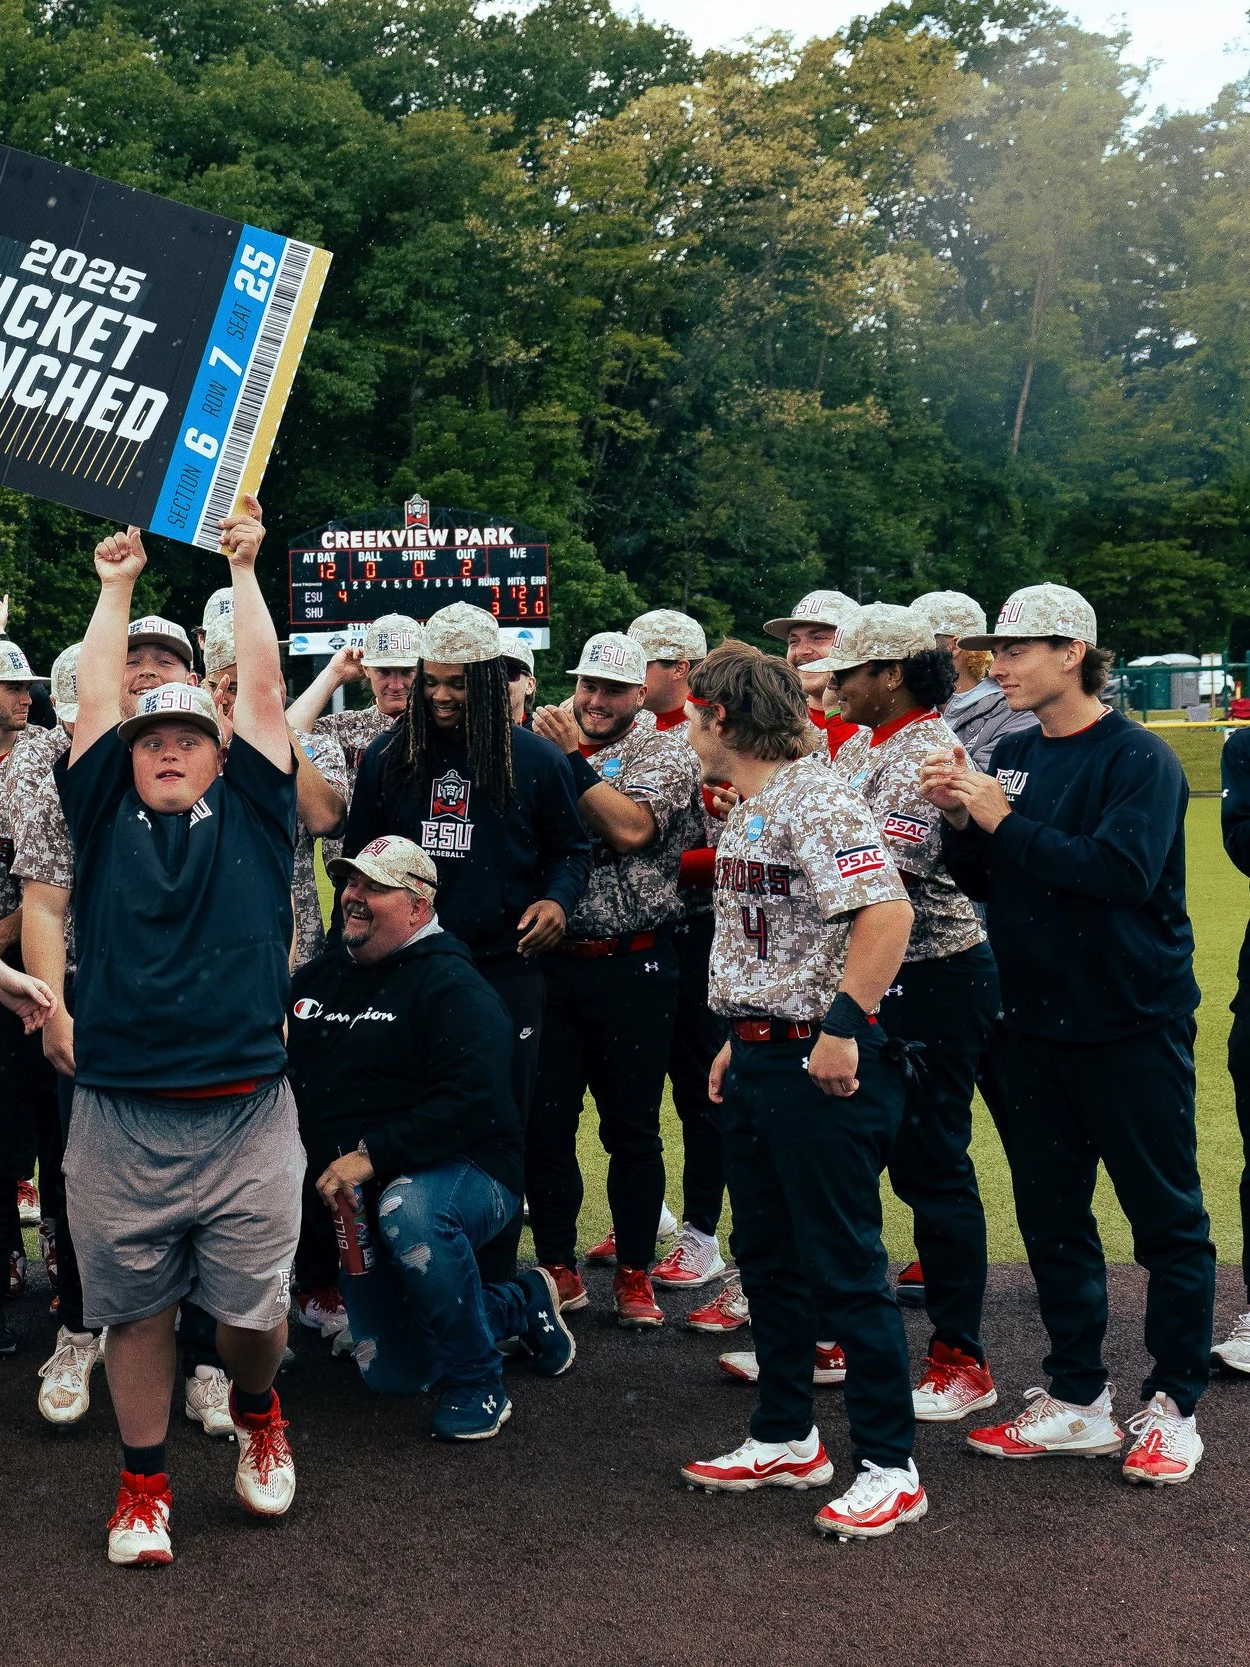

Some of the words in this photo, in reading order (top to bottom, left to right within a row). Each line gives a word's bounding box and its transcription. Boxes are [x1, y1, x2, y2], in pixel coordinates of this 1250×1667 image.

[19, 238, 147, 303] 2025
[233, 243, 276, 304] 25
[226, 300, 253, 341] SEAT
[208, 345, 243, 378] 7
[202, 378, 228, 418] ROW
[183, 426, 220, 460] 6
[167, 463, 203, 530] SECTION
[321, 528, 449, 549] CREEKVIEW
[454, 527, 515, 546] PARK
[302, 552, 315, 563] AT
[317, 551, 336, 563] BAT
[358, 551, 383, 562] BALL
[402, 550, 436, 561] STRIKE
[456, 548, 477, 560] OUT
[509, 547, 527, 559] H/E
[319, 562, 337, 579] 12
[365, 561, 376, 578] 0
[413, 560, 425, 577] 0
[462, 559, 472, 576] 2
[340, 581, 346, 589] 1
[352, 580, 358, 589] 2
[365, 580, 372, 589] 3
[381, 579, 387, 588] 4
[393, 579, 400, 588] 5
[406, 579, 413, 588] 6
[422, 579, 429, 588] 7
[435, 578, 441, 588] 8
[447, 578, 454, 588] 9
[461, 578, 472, 587] 10
[478, 577, 501, 587] RUNS
[507, 576, 526, 586] HITS
[530, 576, 547, 585] ERR
[304, 591, 323, 603] ESU
[337, 590, 348, 602] 4
[491, 586, 500, 599] 7
[511, 585, 527, 599] 12
[539, 586, 544, 598] 1
[305, 607, 324, 618] SHU
[491, 601, 500, 615] 3
[519, 601, 528, 615] 5
[535, 600, 544, 614] 0
[378, 632, 411, 651] ESU
[589, 644, 627, 667] ESU
[144, 690, 195, 714] ESU
[420, 820, 475, 850] ESU
[884, 818, 929, 839] PSAC
[425, 850, 466, 858] BASEBALL
[836, 849, 884, 872] PSAC
[741, 906, 768, 960] 4
[333, 1215, 349, 1249] BILL
